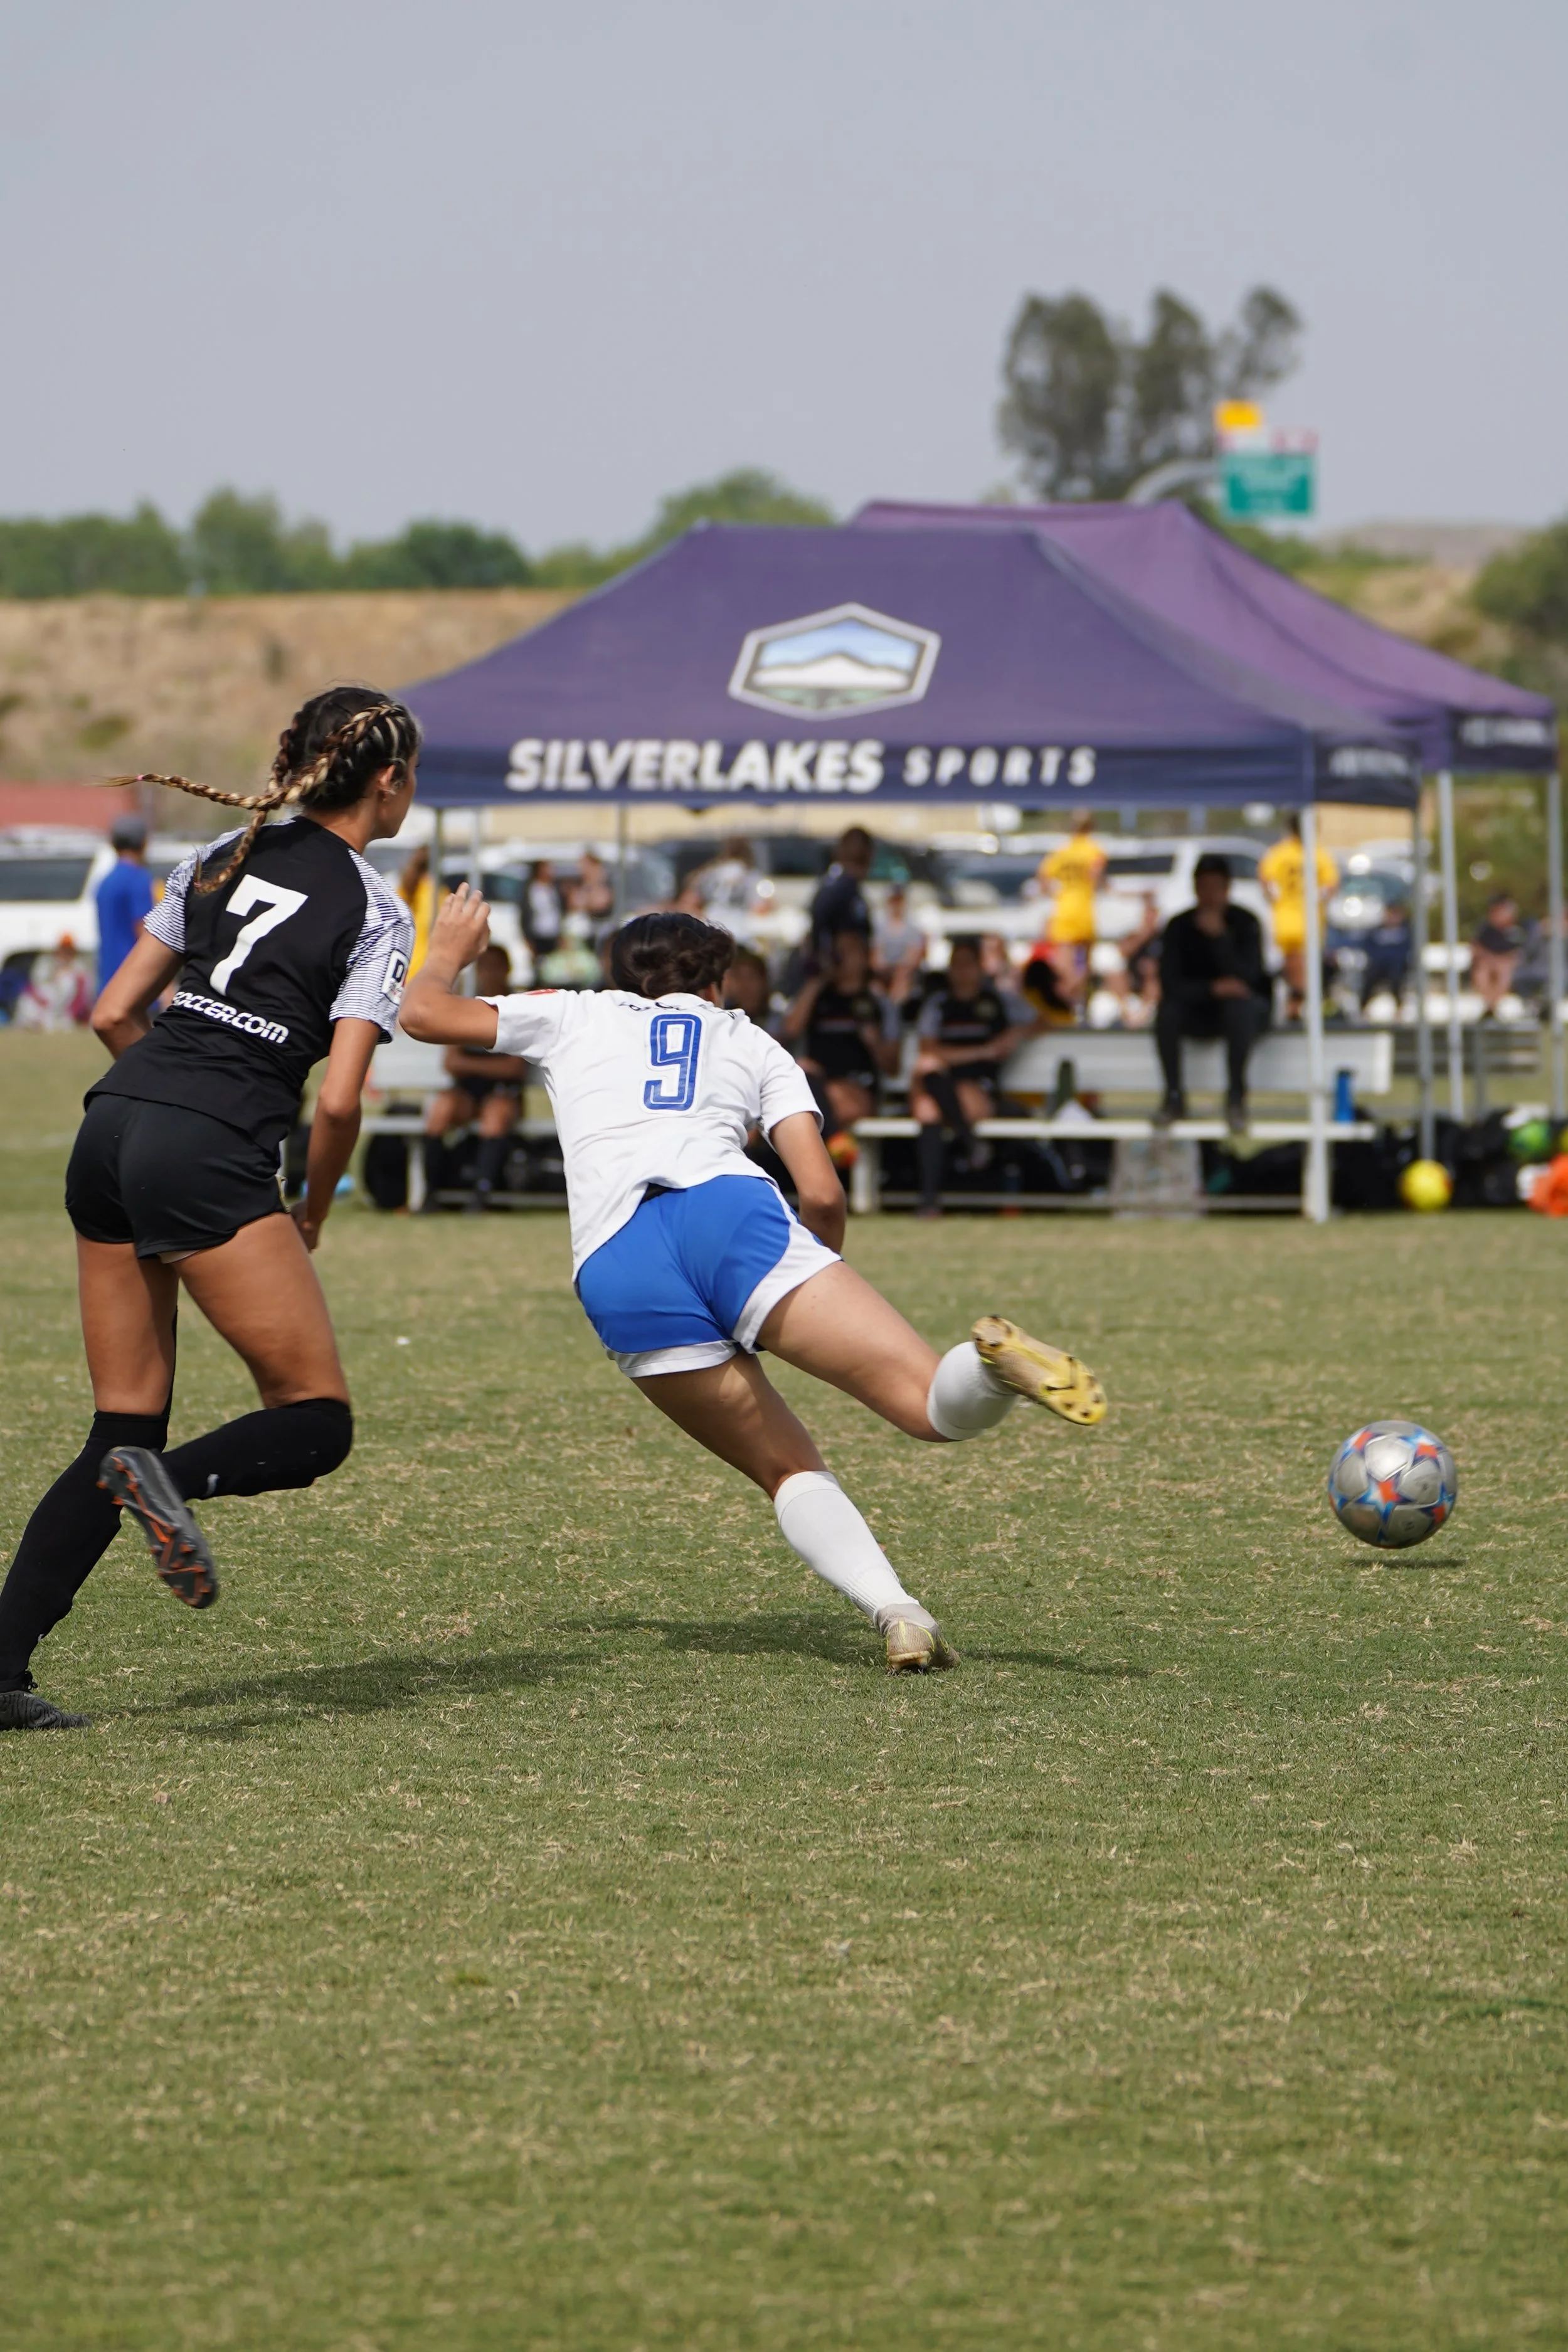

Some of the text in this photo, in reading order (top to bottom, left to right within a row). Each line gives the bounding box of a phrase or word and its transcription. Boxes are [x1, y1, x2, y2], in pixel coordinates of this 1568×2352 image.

[504, 739, 1096, 792] SILVERLAKES SPORTS
[209, 874, 309, 996] 7
[644, 1014, 702, 1111] 9
